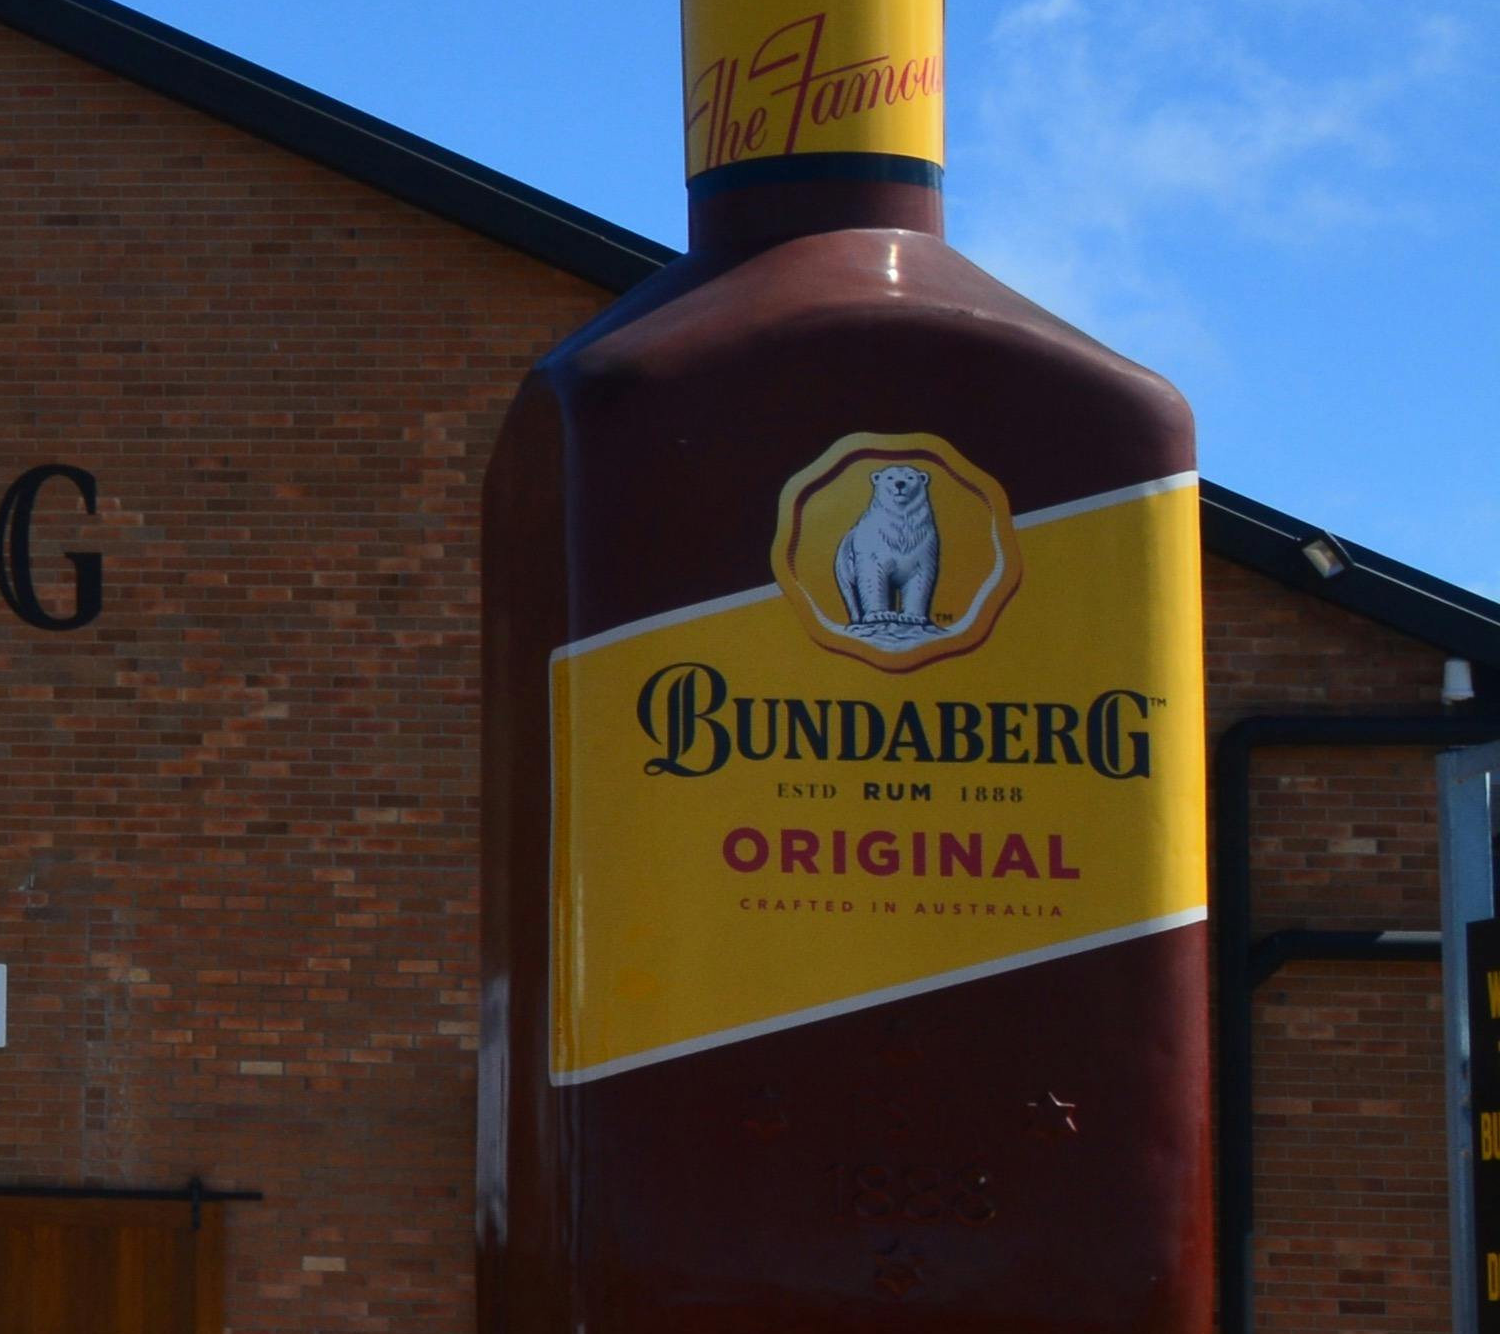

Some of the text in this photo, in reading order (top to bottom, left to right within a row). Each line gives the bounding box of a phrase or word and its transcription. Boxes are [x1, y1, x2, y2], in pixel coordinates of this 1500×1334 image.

[748, 12, 943, 155] Famou
[635, 662, 1152, 780] BUNDABERG
[776, 781, 1024, 805] ESTD RUM 1888
[722, 826, 1081, 880] ORIGINAL
[740, 897, 1064, 919] CRAFTED IN AUSTRALIA
